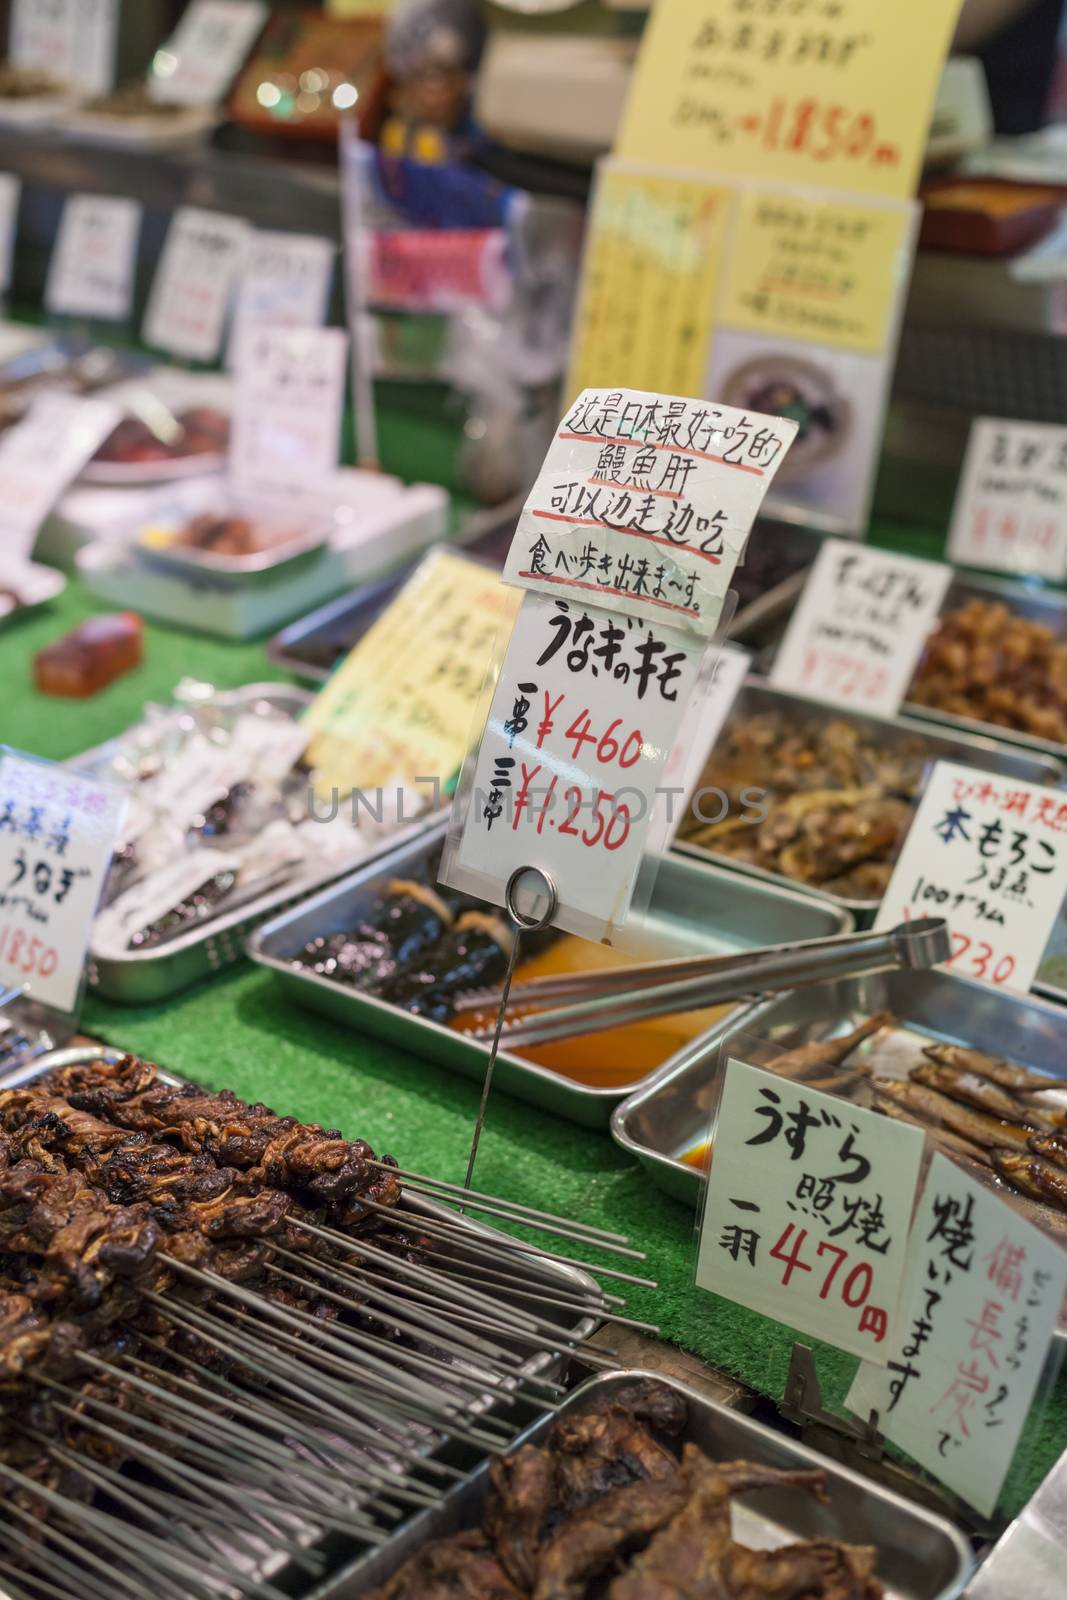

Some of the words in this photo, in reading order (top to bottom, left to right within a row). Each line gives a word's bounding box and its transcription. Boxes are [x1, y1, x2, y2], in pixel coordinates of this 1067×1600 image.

[564, 391, 783, 468] 这是日本最好吃的
[550, 482, 729, 556] 可以边走边吃
[536, 599, 688, 702] うなぎのキモ
[933, 803, 1056, 875] 本もろこ
[744, 1087, 871, 1184] うずら
[786, 1173, 892, 1255] 照焼
[768, 1222, 889, 1343] 470円
[886, 1192, 976, 1413] 焼いてます
